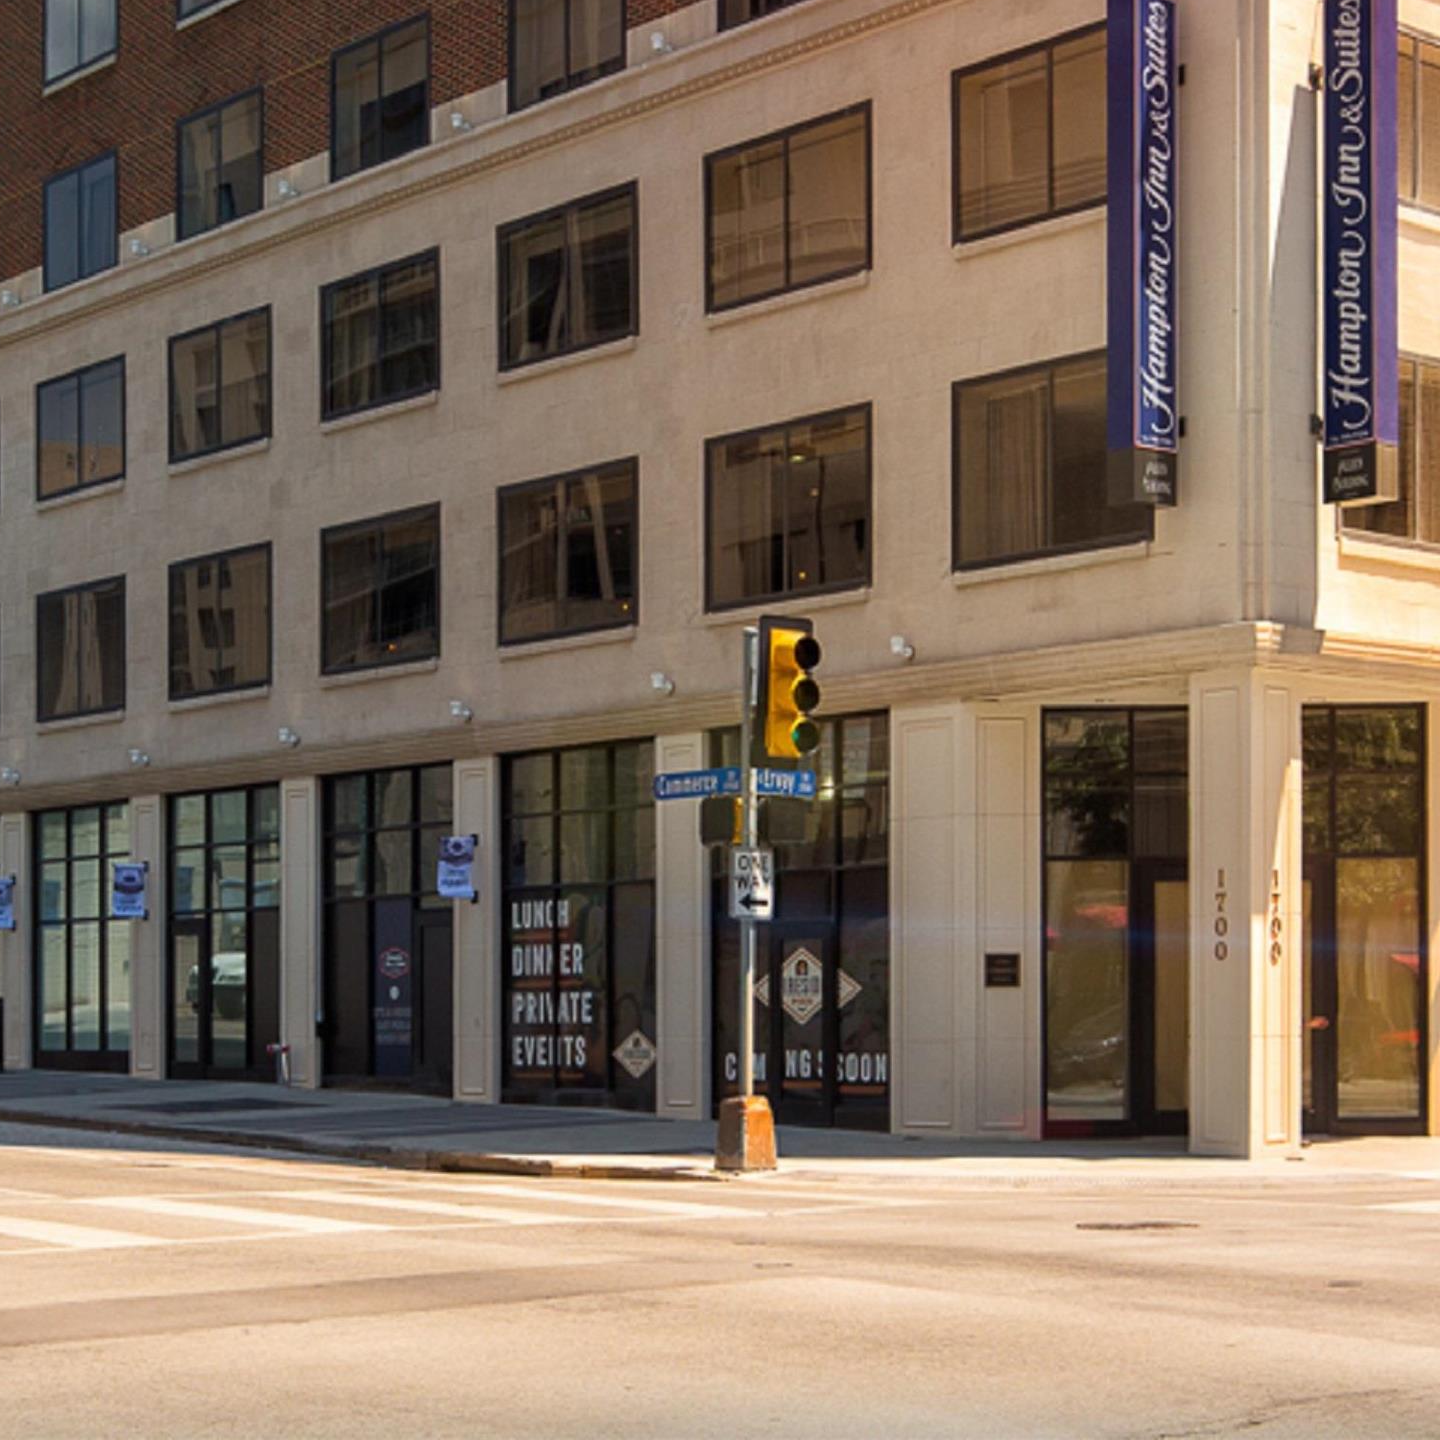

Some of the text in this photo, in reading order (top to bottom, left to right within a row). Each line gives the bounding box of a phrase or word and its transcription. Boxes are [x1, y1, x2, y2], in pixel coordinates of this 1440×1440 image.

[1142, 1, 1169, 109] Suites
[1143, 126, 1172, 232] Inn
[1330, 124, 1367, 226] Inn
[1140, 234, 1174, 434] Hampton
[1328, 232, 1372, 430] Hampton
[660, 774, 718, 796] Commerce
[736, 874, 771, 890] WAY
[737, 854, 769, 870] ONE
[1214, 869, 1228, 961] 1700
[724, 1049, 812, 1082] CMNG
